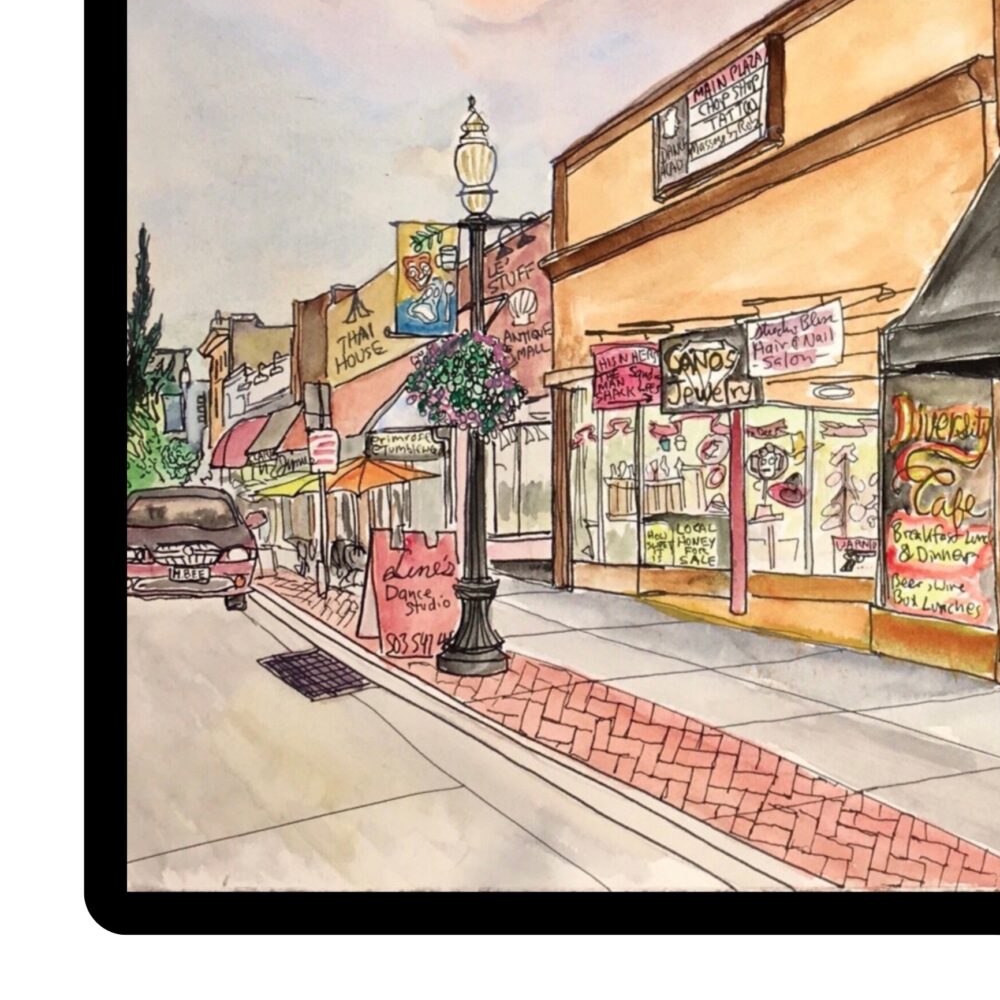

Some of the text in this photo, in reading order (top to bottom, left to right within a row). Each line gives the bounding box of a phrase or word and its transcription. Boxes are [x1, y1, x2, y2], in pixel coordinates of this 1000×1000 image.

[692, 50, 762, 103] MAIN PLAZA
[698, 72, 760, 117] CHOP SHOP
[487, 261, 536, 295] STUFF
[336, 322, 374, 356] THAI
[503, 321, 552, 345] ANTIQUE
[752, 339, 788, 361] Hair
[803, 326, 834, 348] Nail
[334, 341, 387, 375] HOUSE
[597, 376, 625, 391] MAN
[666, 377, 754, 406] Jewelry
[675, 522, 718, 536] LOCAL
[676, 534, 717, 549] HONEY
[684, 546, 709, 556] FOR
[679, 554, 717, 567] SALE
[916, 545, 979, 565] Dinner
[385, 584, 433, 602] Dance
[922, 596, 982, 620] Lunches
